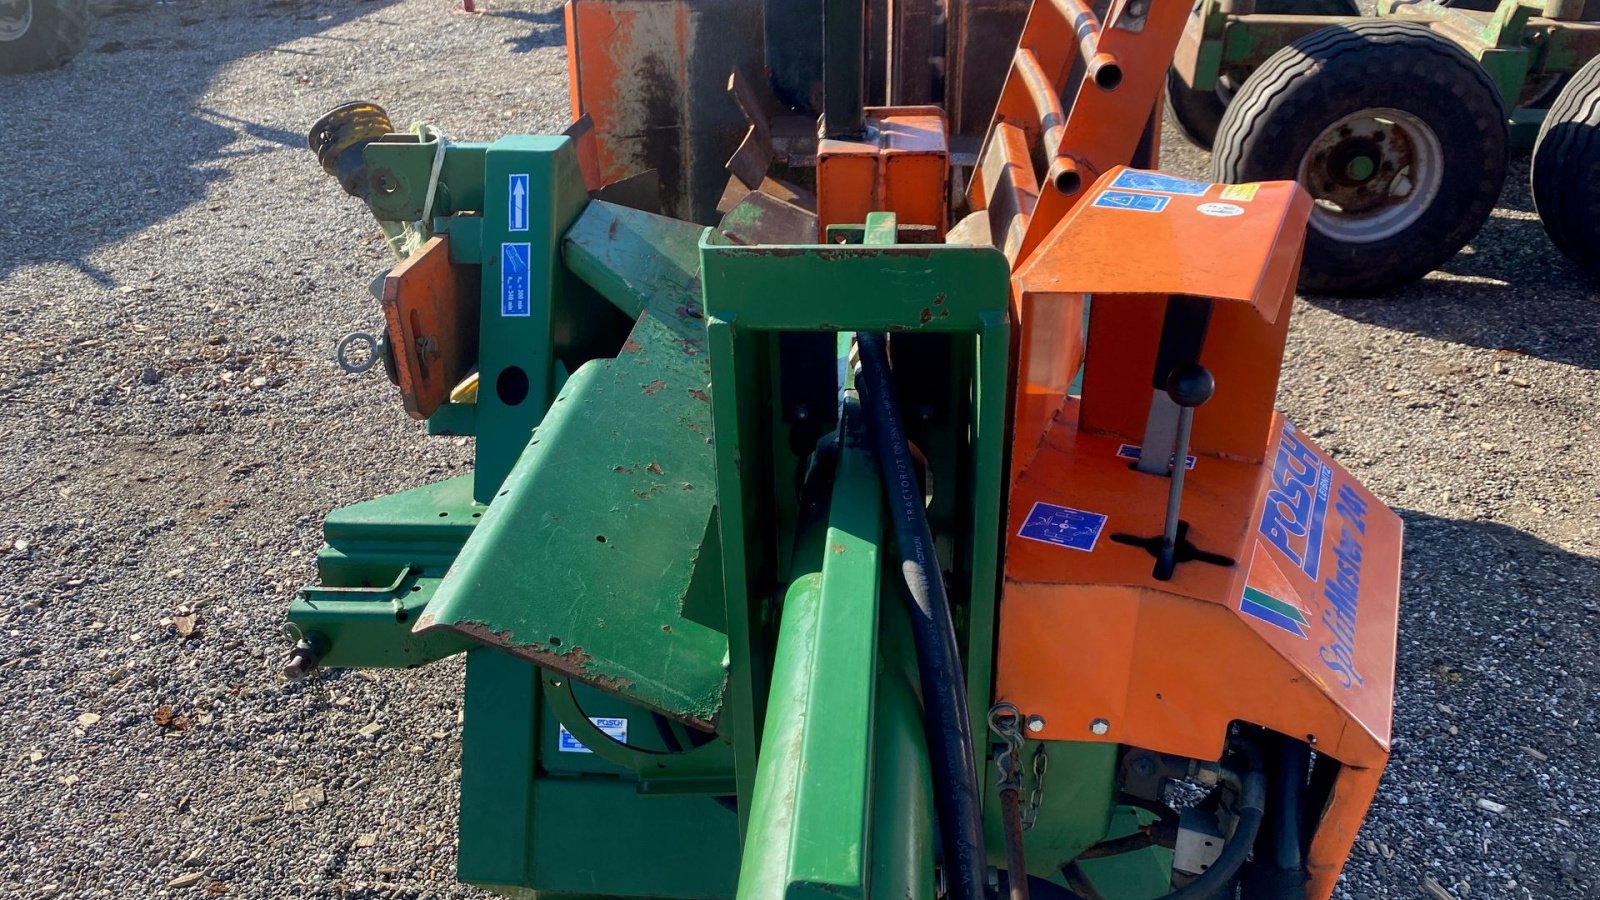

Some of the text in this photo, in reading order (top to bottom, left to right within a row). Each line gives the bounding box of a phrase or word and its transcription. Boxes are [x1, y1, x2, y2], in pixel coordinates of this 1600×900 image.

[1259, 428, 1320, 568] POSCH
[1317, 467, 1332, 502] LEIBNITZ
[1319, 482, 1368, 689] SplitMaster 24t
